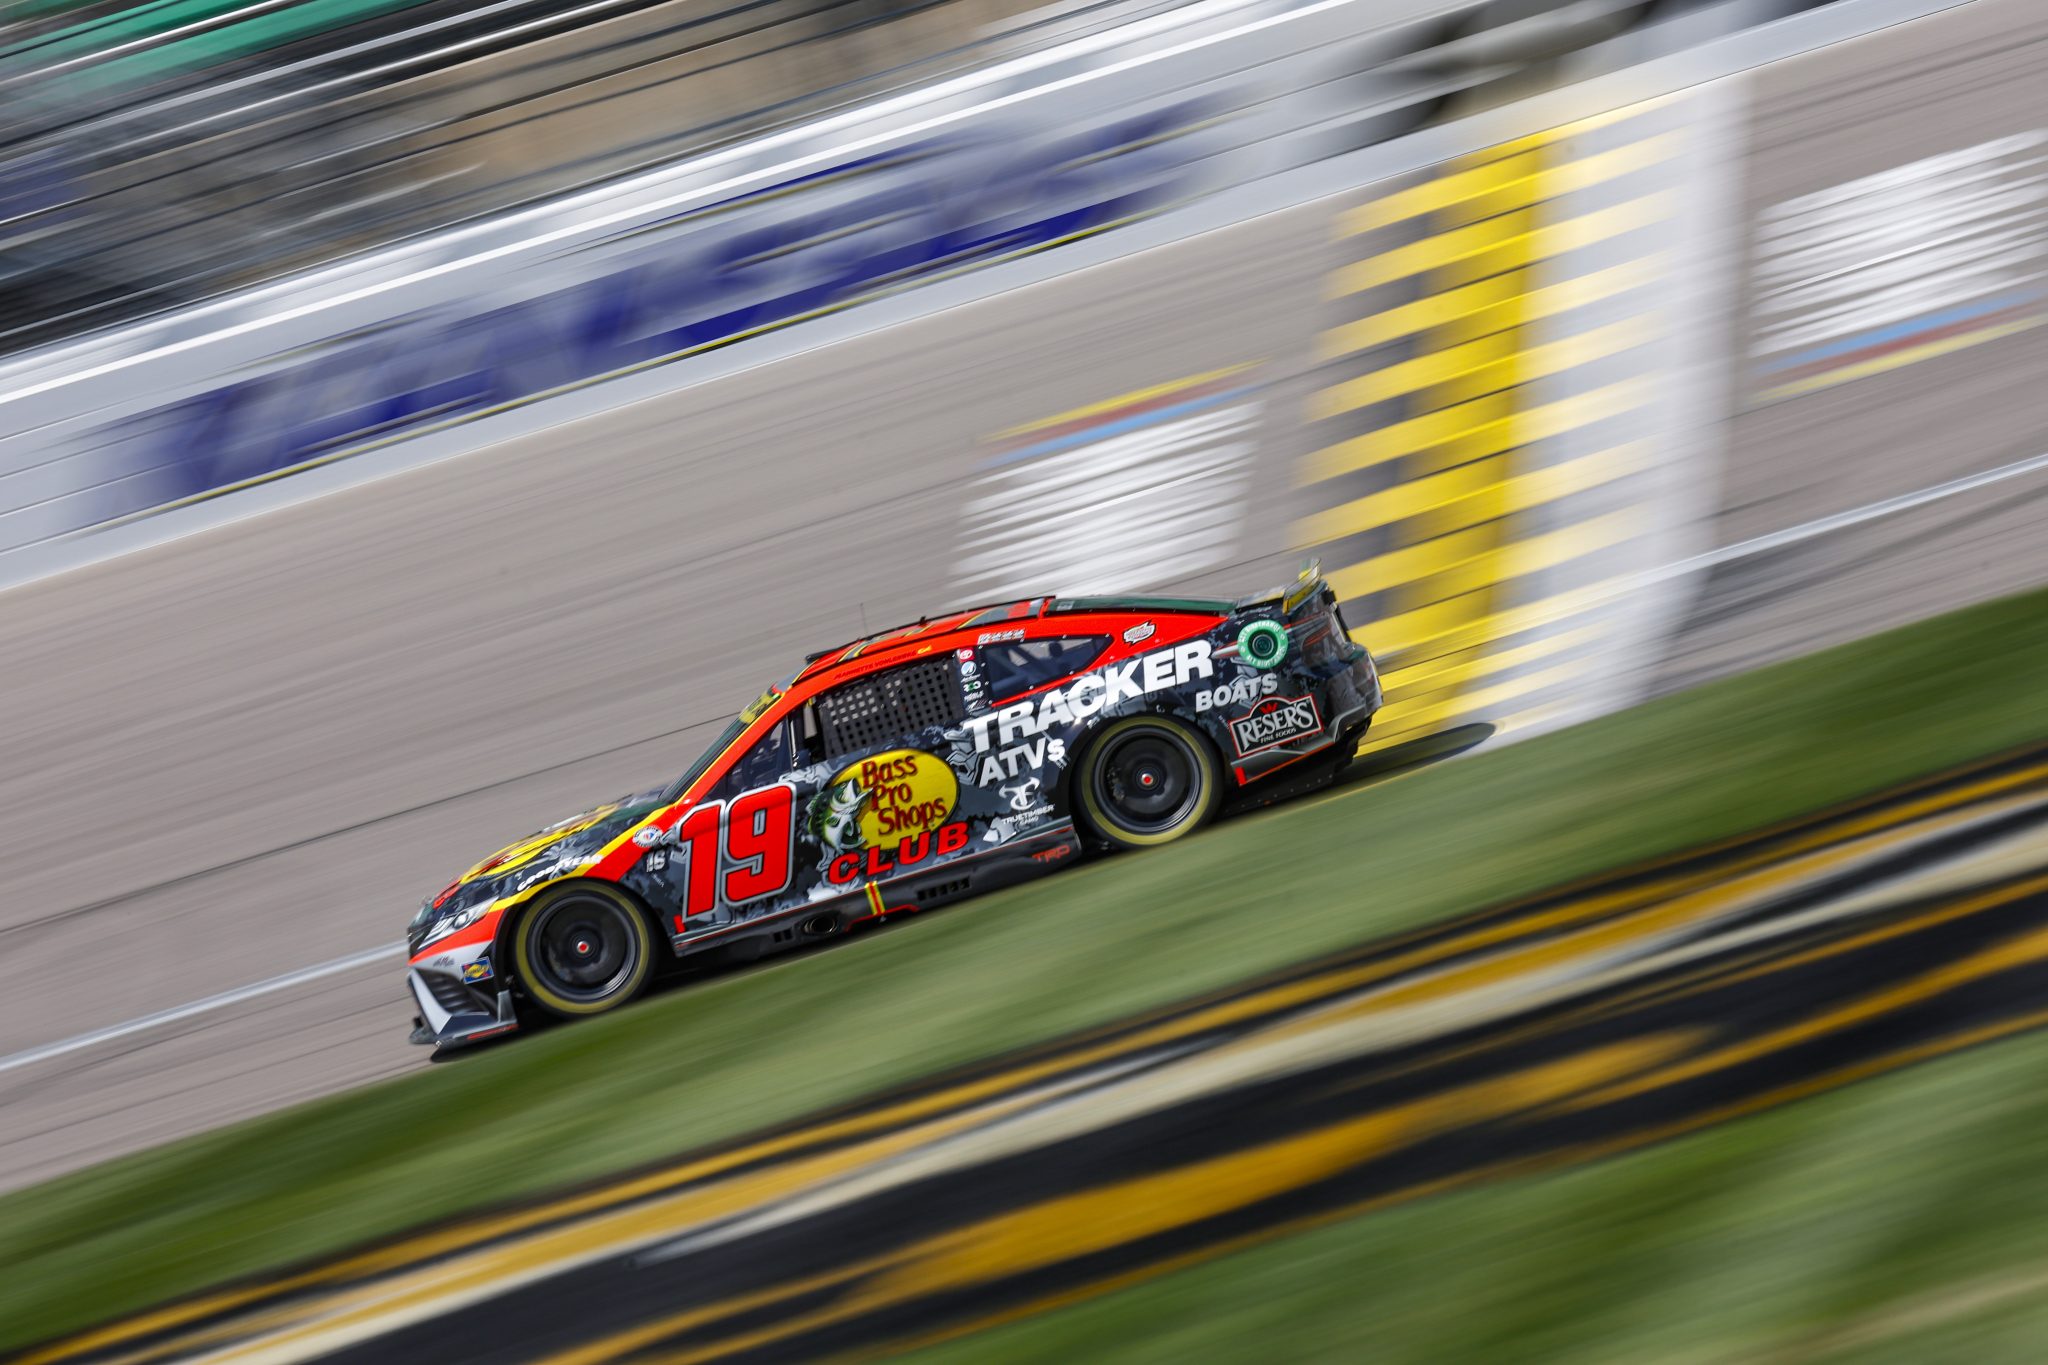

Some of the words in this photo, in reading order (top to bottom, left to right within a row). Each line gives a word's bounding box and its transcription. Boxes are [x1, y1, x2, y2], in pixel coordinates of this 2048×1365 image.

[961, 640, 1214, 754] TRACKER
[1195, 673, 1278, 712] BOATS
[1237, 700, 1314, 752] RESER'S
[861, 755, 918, 789] Bass
[871, 783, 913, 811] Pro
[877, 798, 948, 836] Shops
[678, 783, 797, 922] 19
[828, 820, 969, 884] CLUB
[517, 854, 603, 892] GOODYEAR
